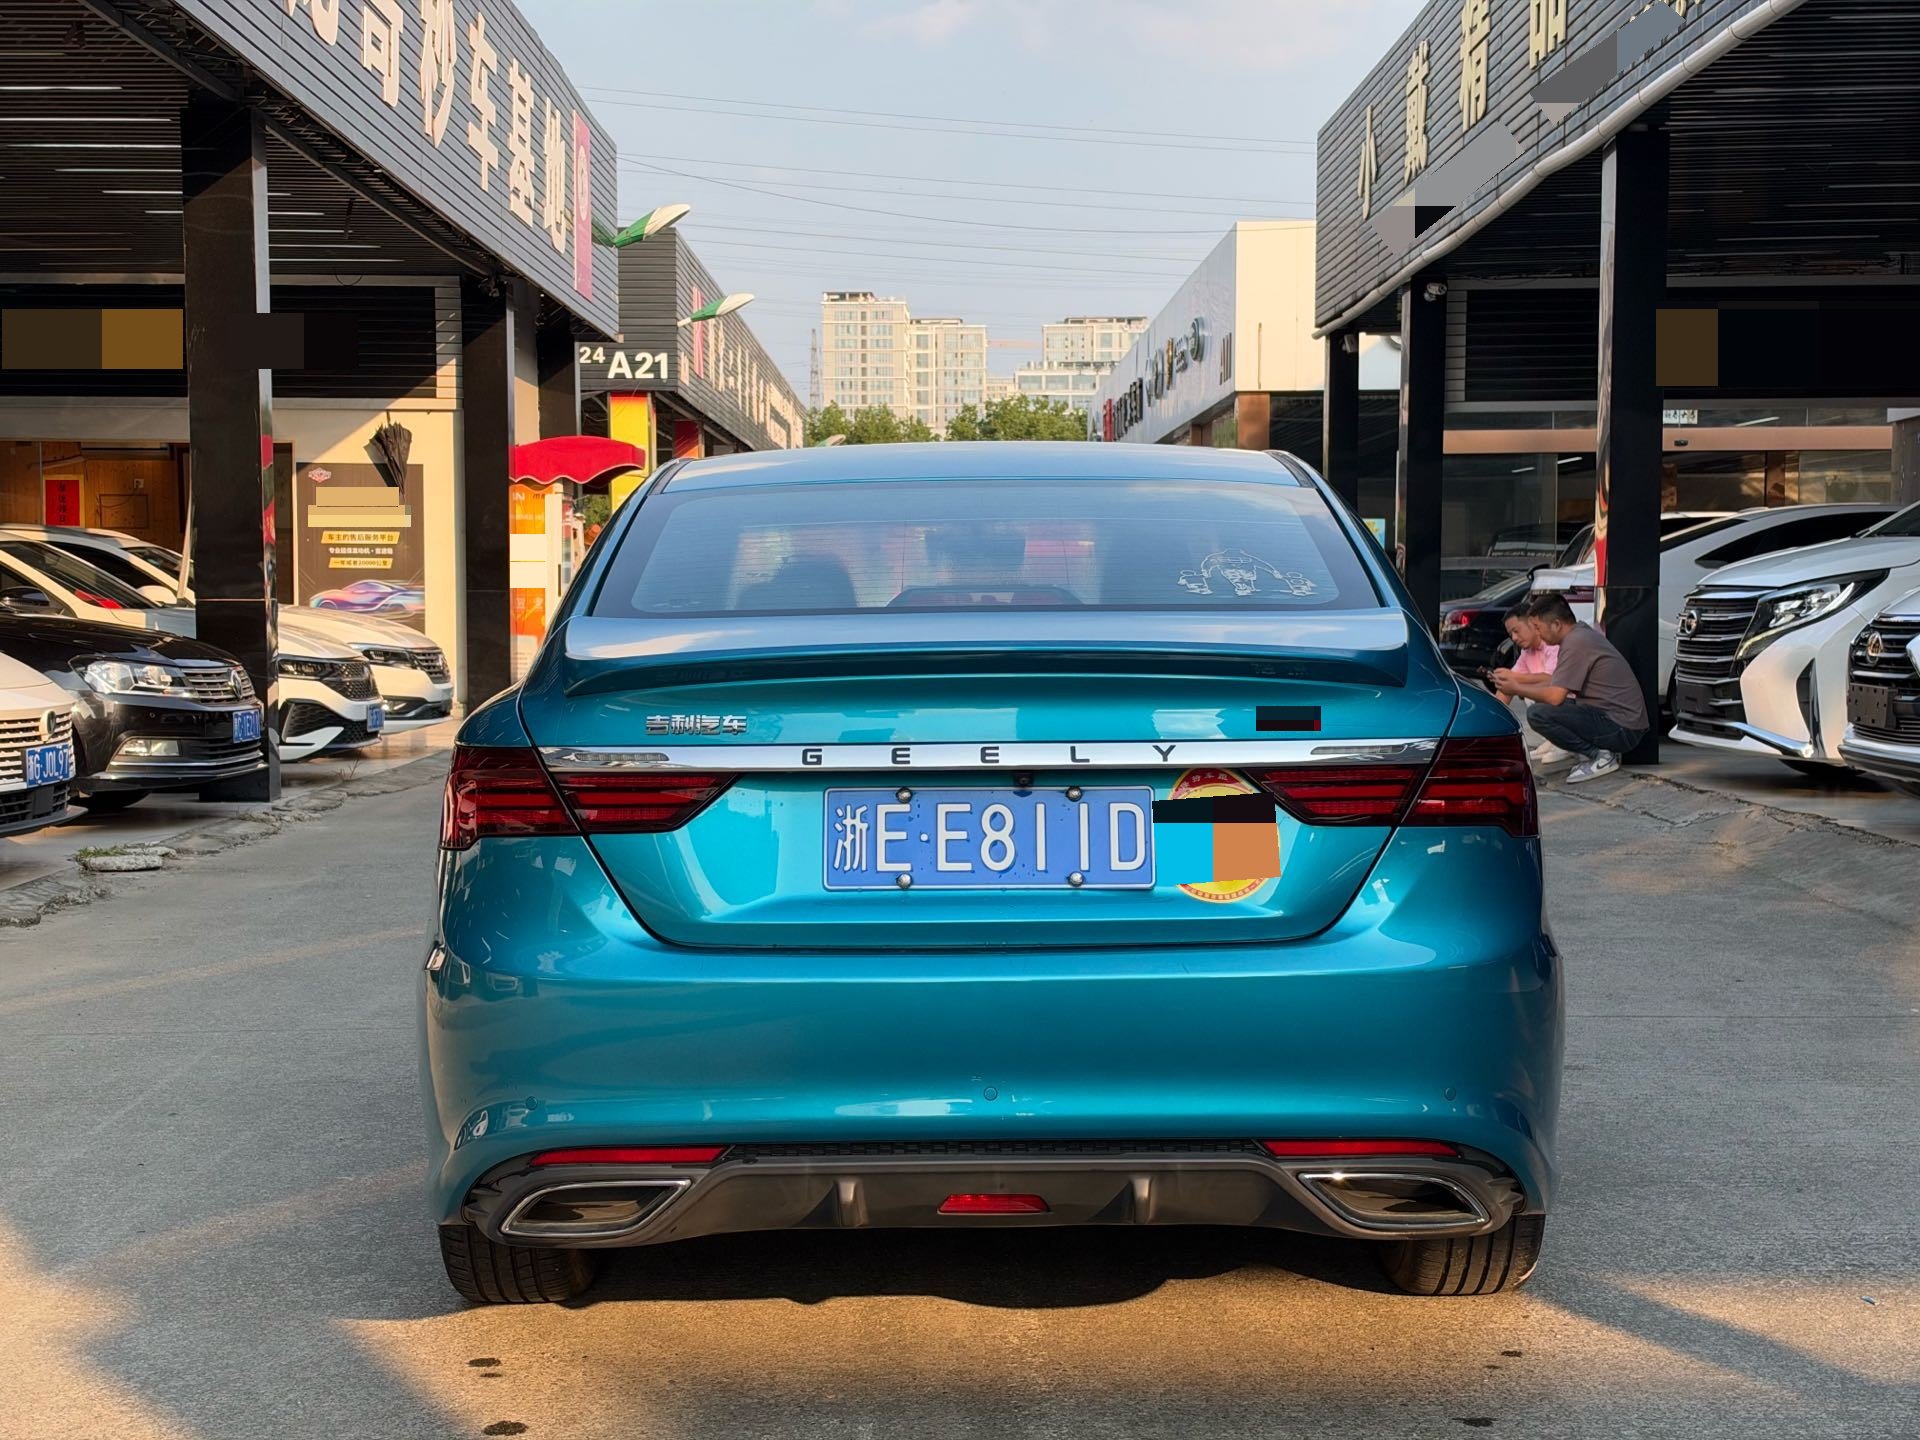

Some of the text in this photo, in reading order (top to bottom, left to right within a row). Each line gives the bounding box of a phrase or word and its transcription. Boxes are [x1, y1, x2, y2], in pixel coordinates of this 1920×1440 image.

[579, 346, 606, 364] 24
[607, 351, 669, 379] A21
[646, 714, 747, 735] 吉利汽车
[801, 744, 1176, 766] GEELY
